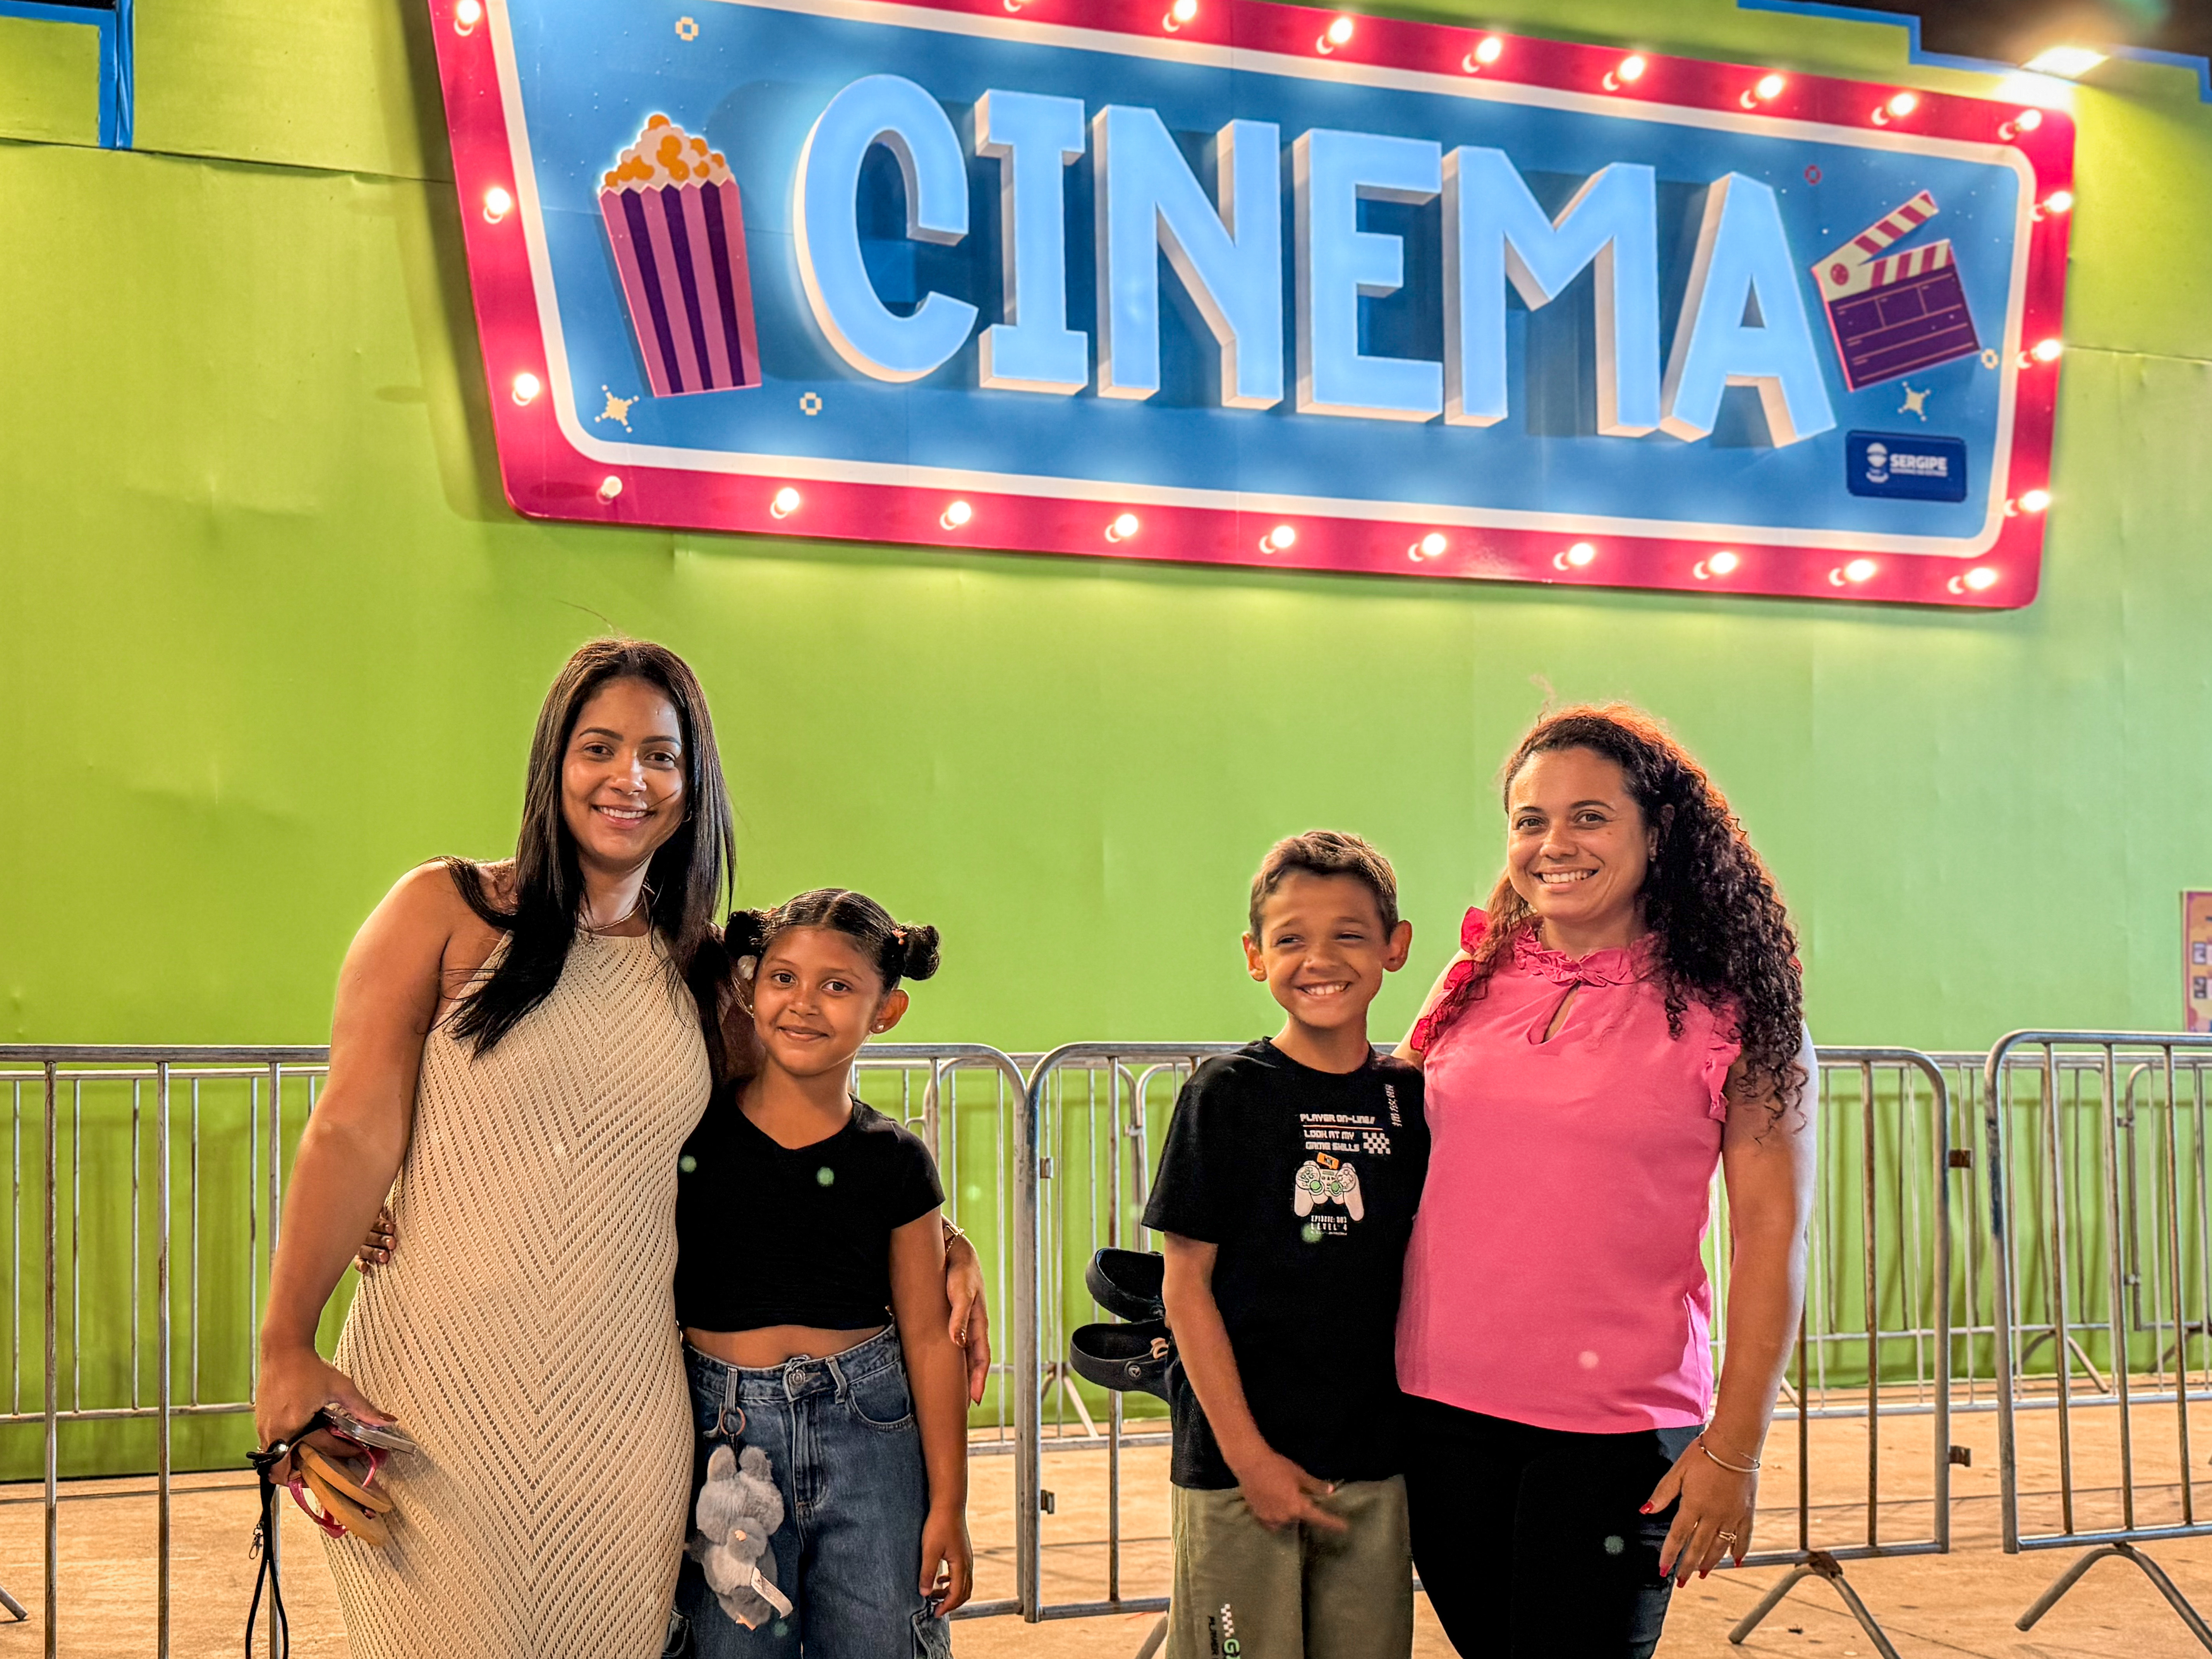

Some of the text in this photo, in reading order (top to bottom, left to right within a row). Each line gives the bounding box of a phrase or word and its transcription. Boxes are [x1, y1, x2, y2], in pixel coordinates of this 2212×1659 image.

[793, 73, 1836, 447] CINEMA
[1890, 453, 1948, 471] SERGIPE
[1300, 1114, 1336, 1122] PLAYER
[1304, 1130, 1354, 1140] LOOK AT MY
[1305, 1142, 1360, 1152] GAME SKILLS
[1311, 1223, 1337, 1231] LEVEL
